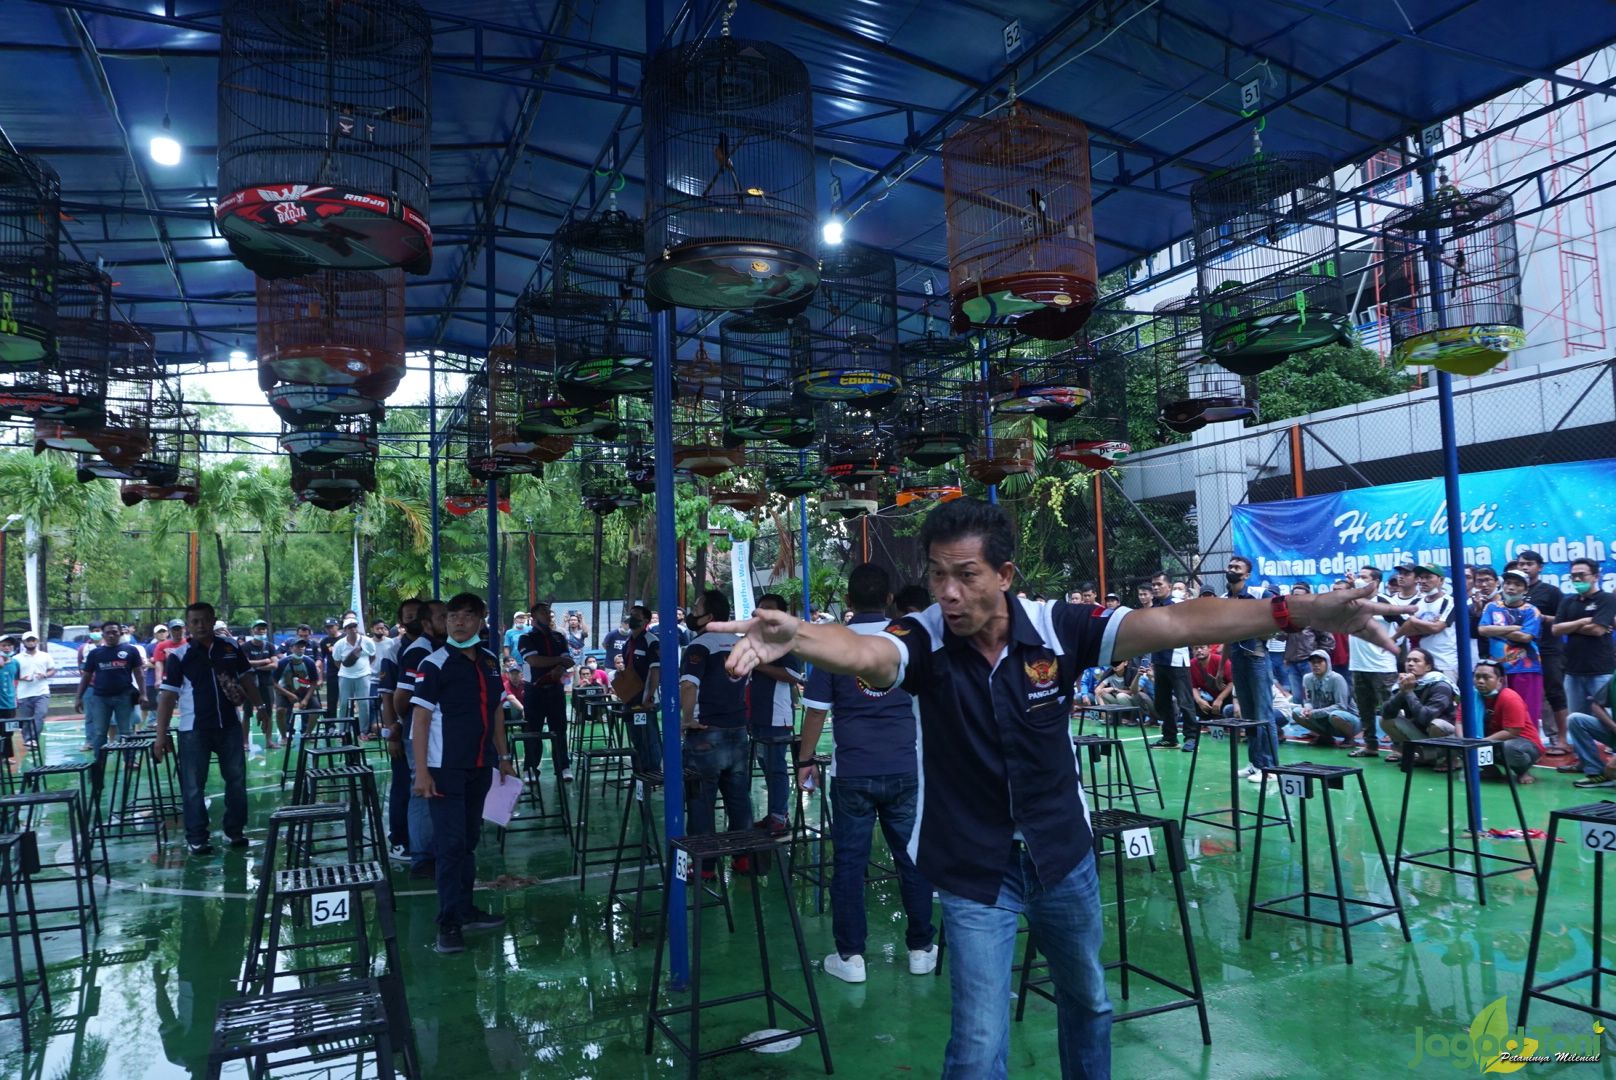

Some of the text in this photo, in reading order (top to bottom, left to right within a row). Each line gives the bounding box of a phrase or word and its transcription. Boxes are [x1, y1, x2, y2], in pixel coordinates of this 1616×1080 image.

[1006, 24, 1020, 48] 52
[1244, 84, 1259, 104] 51
[1424, 127, 1442, 144] 50
[343, 193, 386, 208] RADJA
[277, 206, 307, 224] RADJA
[1212, 728, 1224, 741] 49
[1479, 749, 1492, 765] 50
[1284, 779, 1302, 796] 51
[1129, 834, 1151, 857] 61
[1584, 828, 1616, 852] 62
[313, 897, 348, 922] 54
